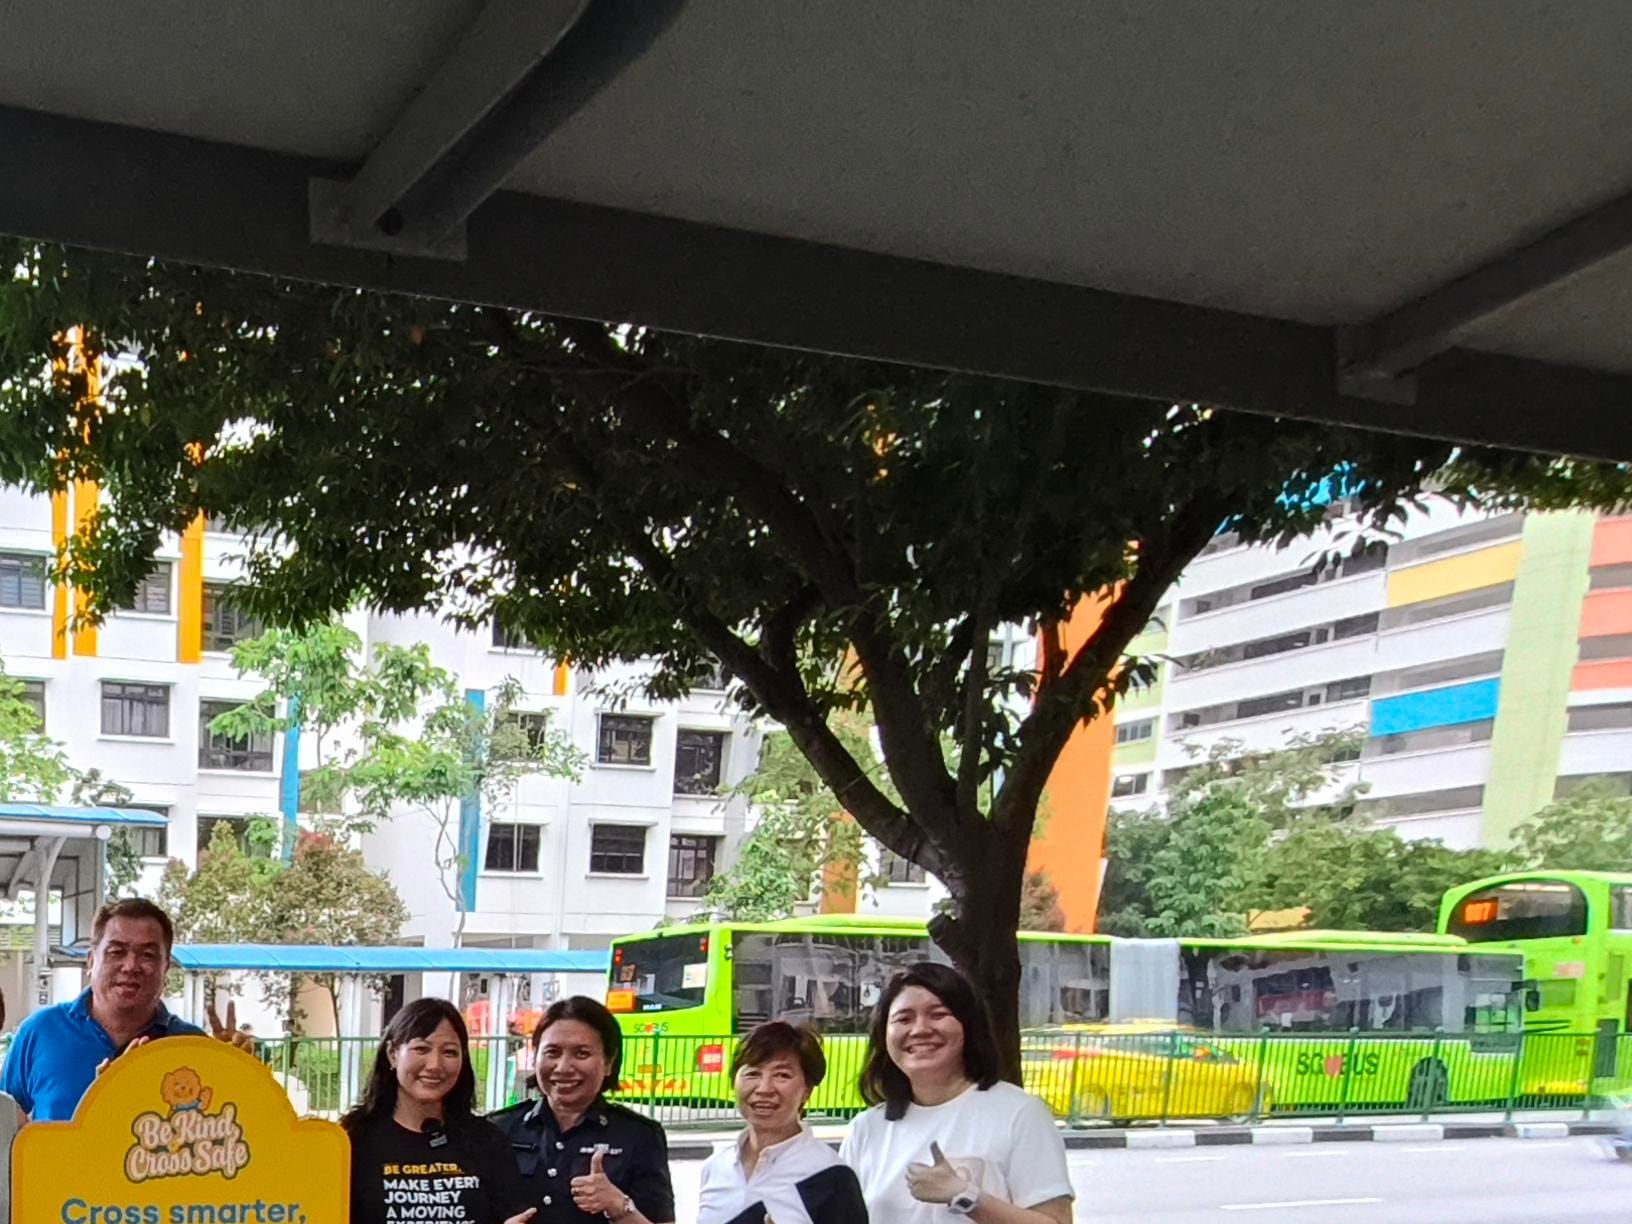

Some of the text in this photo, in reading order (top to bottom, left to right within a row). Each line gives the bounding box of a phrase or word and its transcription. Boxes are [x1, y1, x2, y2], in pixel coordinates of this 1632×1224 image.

[133, 1112, 174, 1150] Be
[125, 1139, 250, 1183] Cross Safe
[383, 1162, 462, 1175] BE GREATER.
[384, 1178, 430, 1191] MAKE
[384, 1191, 461, 1204] JOURNEY
[386, 1206, 465, 1219] A MOVING
